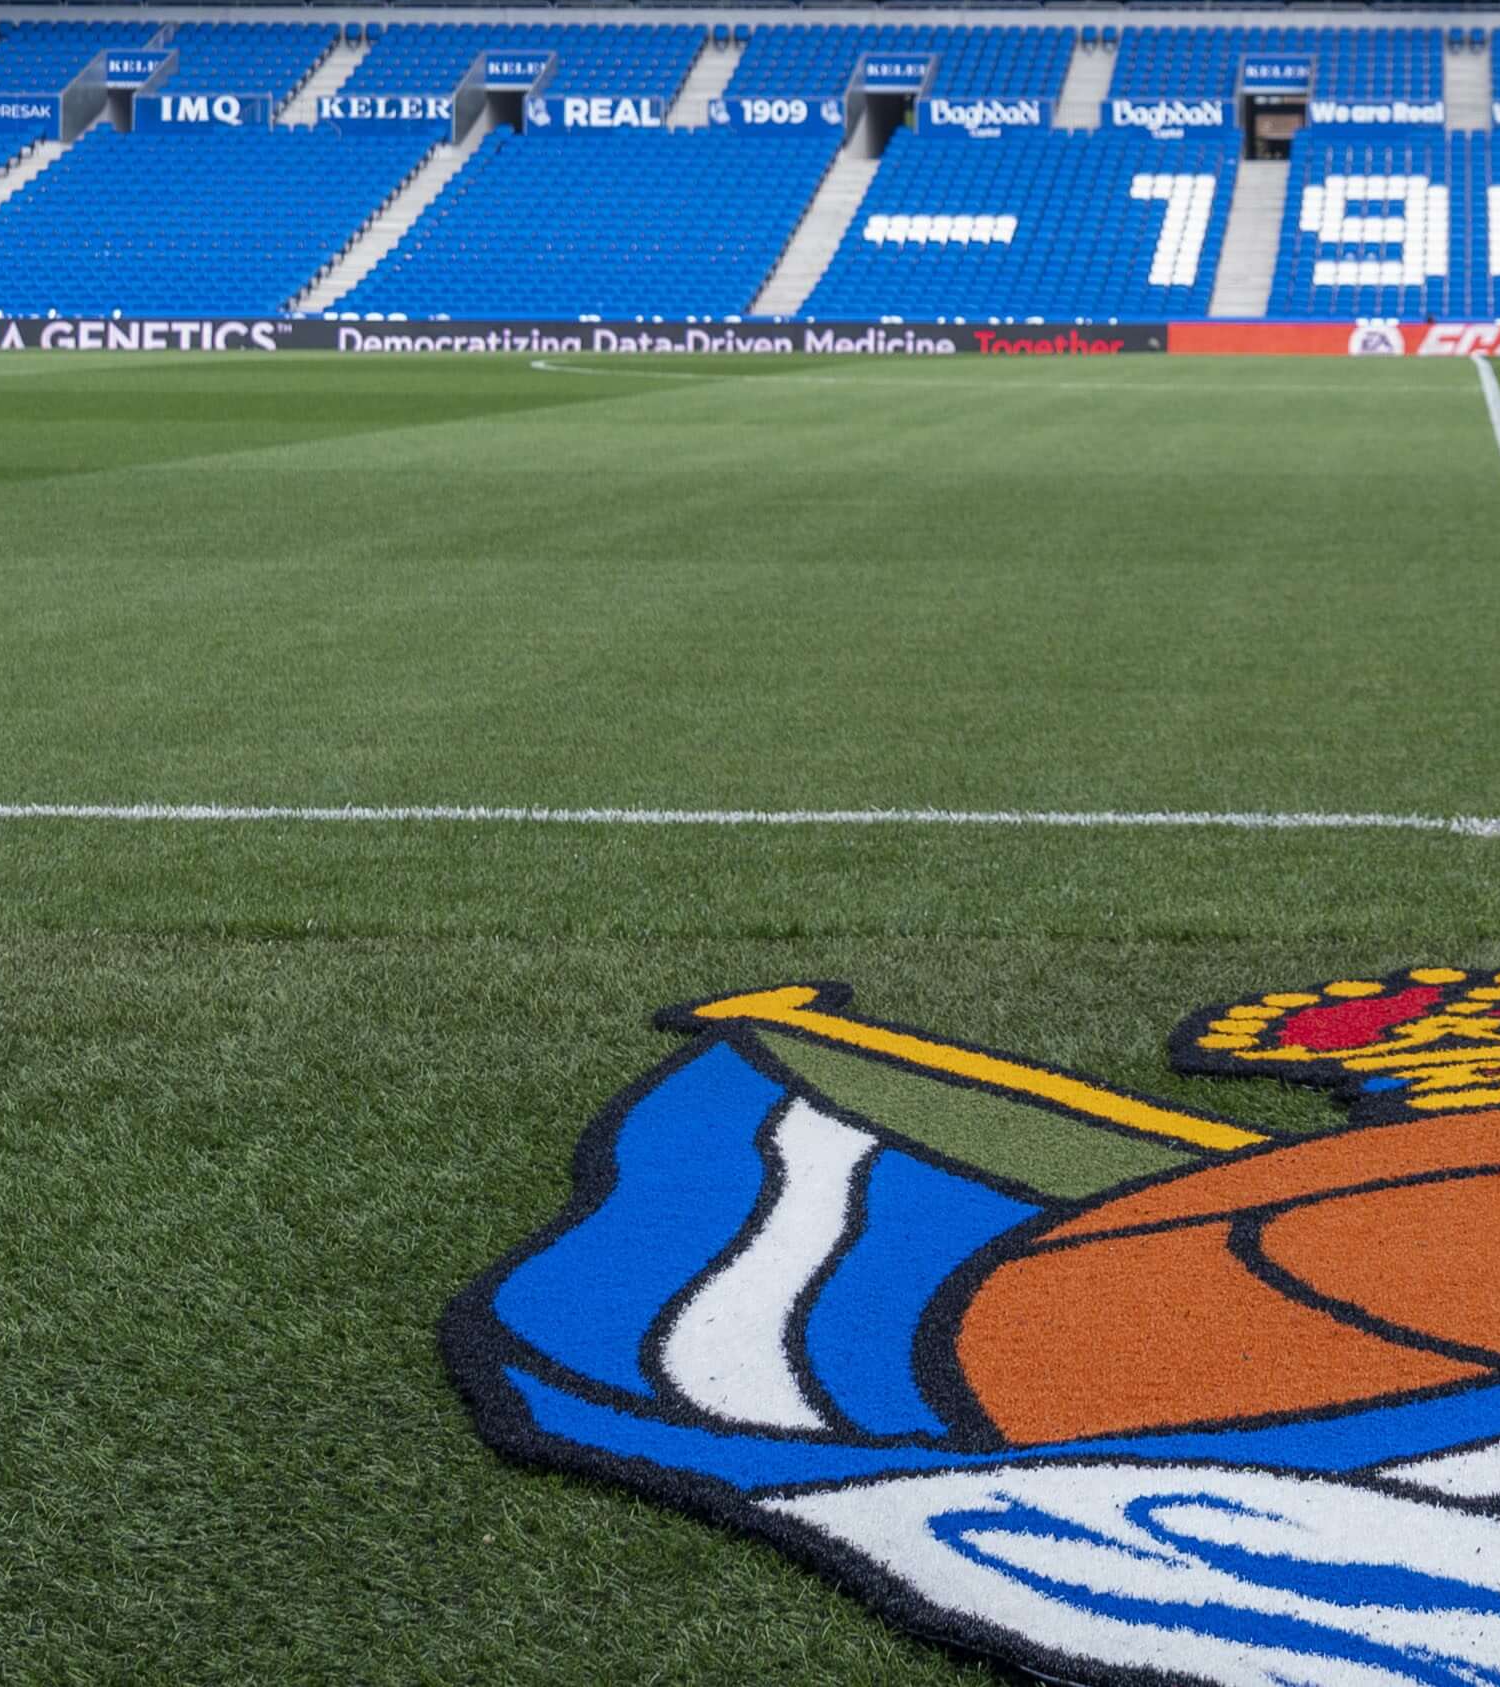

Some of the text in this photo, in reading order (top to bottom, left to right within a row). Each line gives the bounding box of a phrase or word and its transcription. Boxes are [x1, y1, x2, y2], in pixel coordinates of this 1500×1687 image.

[160, 96, 243, 127] IMQ
[320, 96, 452, 120] KELER
[563, 97, 662, 128] REAL
[740, 99, 808, 124] 1909
[1310, 102, 1444, 123] We are Real
